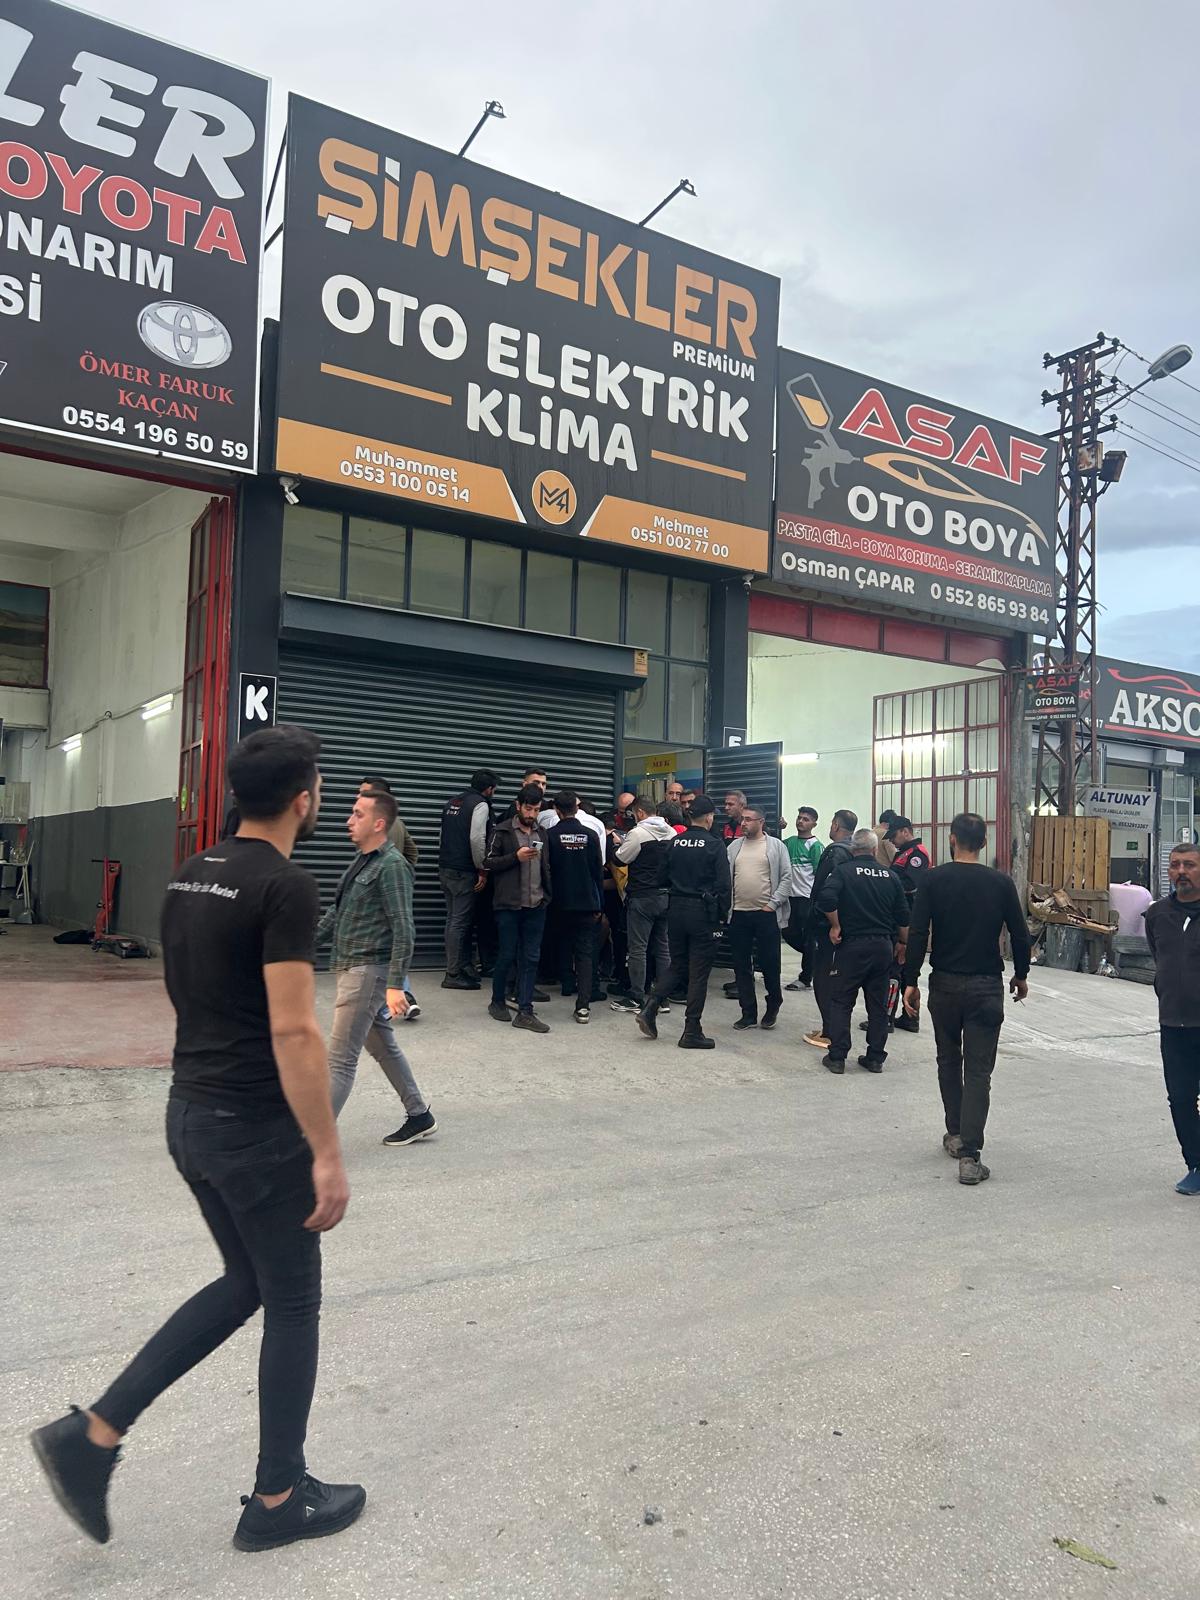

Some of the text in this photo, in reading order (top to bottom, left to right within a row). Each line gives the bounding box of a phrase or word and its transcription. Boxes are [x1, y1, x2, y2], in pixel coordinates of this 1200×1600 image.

[0, 211, 174, 293] NARIM
[317, 137, 758, 360] ŞİMŞEKLER
[79, 350, 235, 405] ÖMER FARUK
[321, 274, 751, 442] OTO ELEKTRİK
[117, 388, 199, 422] KAÇAN
[62, 405, 249, 461] 0554 196 50 59
[838, 388, 1048, 485] ASAF
[340, 460, 470, 503] 0553 100 05 14
[355, 445, 459, 483] Muhammet
[631, 526, 729, 558] 0551 002 77 00
[653, 515, 709, 539] Mehmet
[847, 485, 1041, 566] OTO BOYA
[777, 518, 822, 543] PASTA
[822, 528, 853, 549] CİLA
[860, 537, 896, 560] BOYA
[896, 545, 949, 572] KORUMA
[1004, 571, 1053, 598] KAPLAMA
[781, 551, 850, 582] Osman
[854, 566, 915, 595] ÇAPAR
[930, 583, 942, 600] 0
[945, 586, 974, 608] 552
[977, 593, 1006, 614] 865
[1009, 600, 1027, 619] 93
[1030, 606, 1050, 625] 84
[246, 684, 269, 721] K
[1035, 696, 1075, 707] OTO BOYA
[1036, 675, 1077, 689] ASAF
[1090, 790, 1150, 806] ALTUNAY
